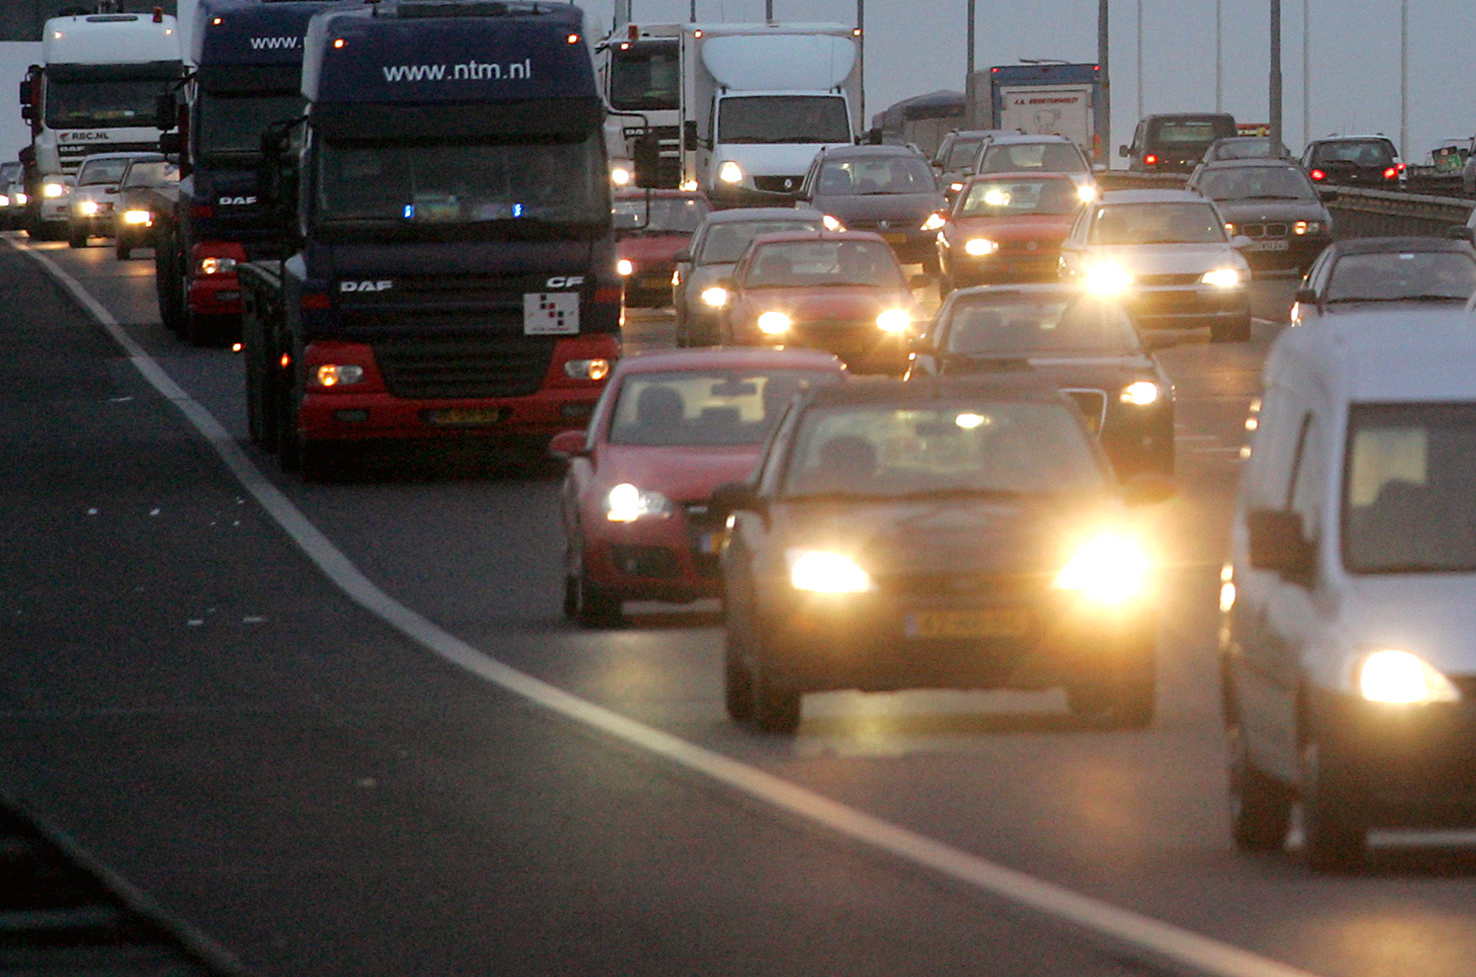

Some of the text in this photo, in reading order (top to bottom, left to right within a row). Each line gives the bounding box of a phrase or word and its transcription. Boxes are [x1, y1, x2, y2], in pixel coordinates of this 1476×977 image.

[383, 58, 531, 82] www.ntm.nl
[219, 196, 257, 205] DAF
[340, 280, 392, 292] DAF
[546, 276, 584, 288] CF
